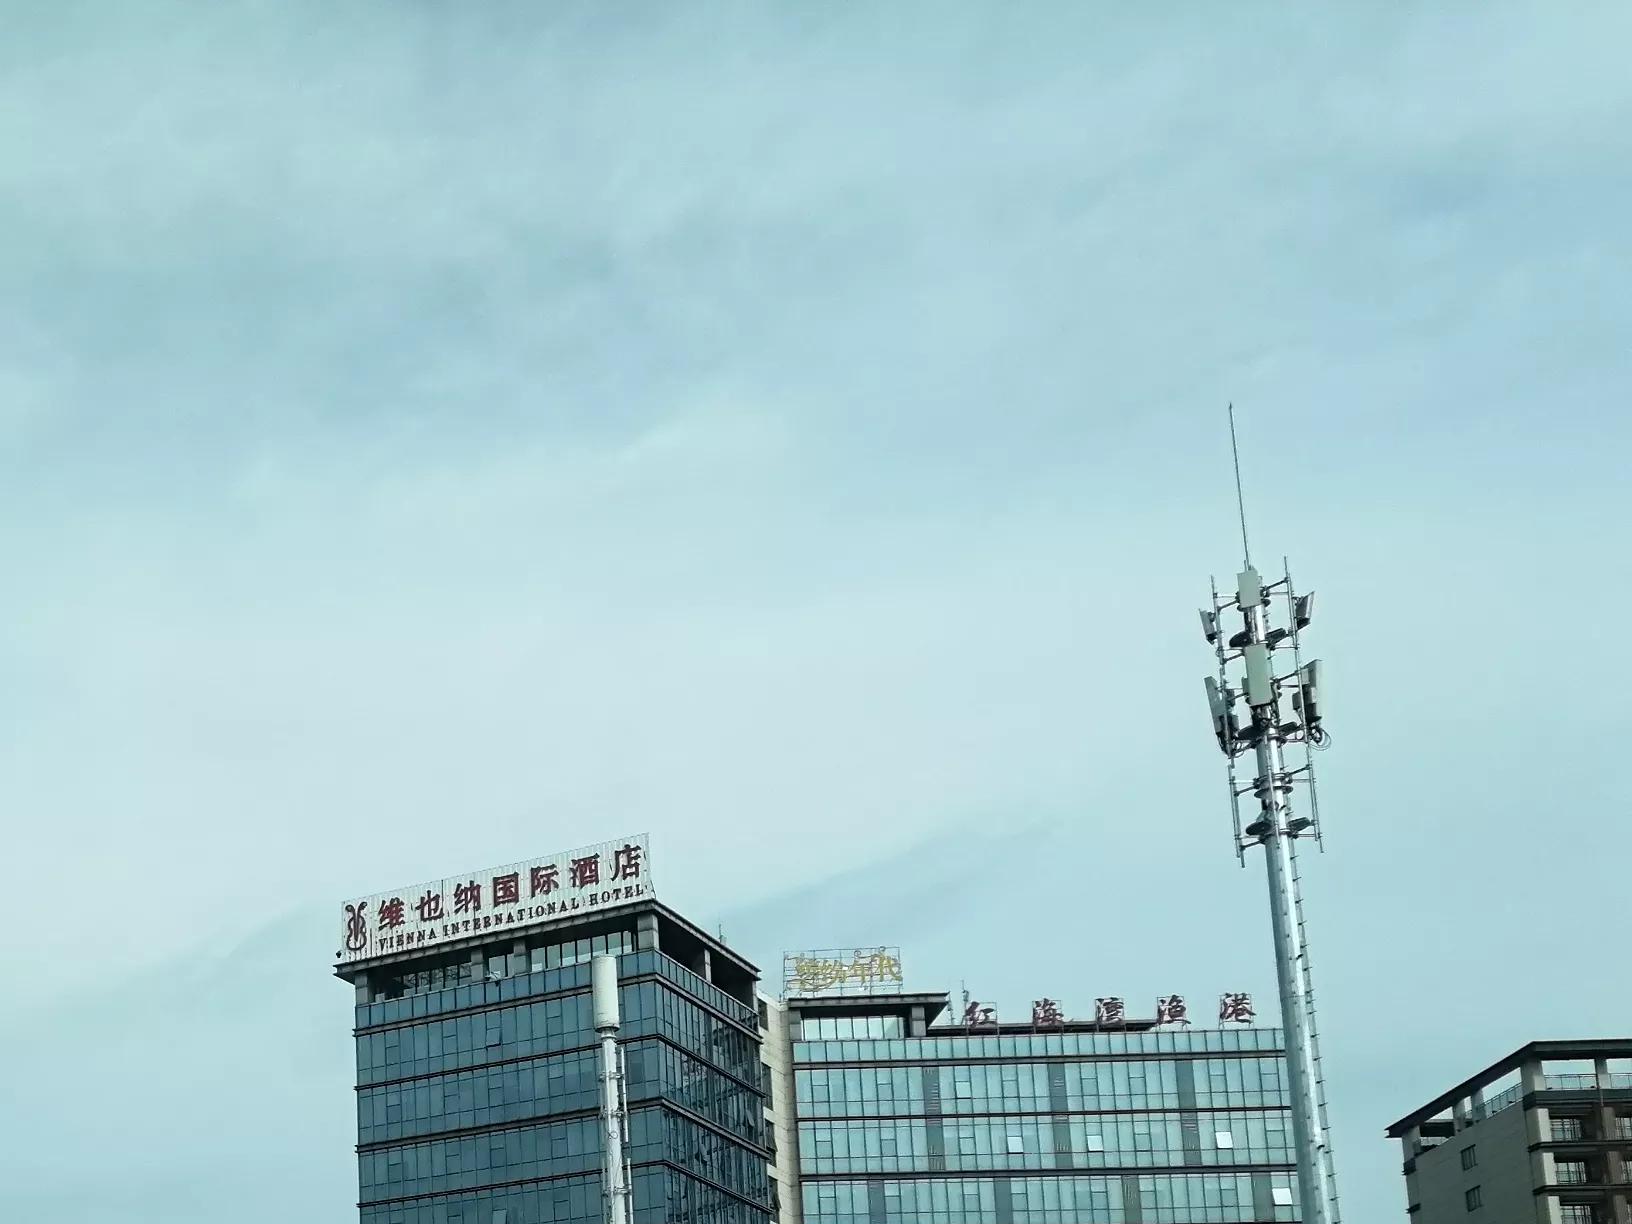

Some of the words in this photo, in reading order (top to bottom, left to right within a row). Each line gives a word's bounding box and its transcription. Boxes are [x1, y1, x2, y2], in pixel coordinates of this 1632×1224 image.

[377, 843, 642, 931] 维也纳国际酒店
[378, 927, 438, 951] VIENNA
[442, 898, 580, 937] INTERNATIONAL
[588, 884, 645, 907] HOTEL
